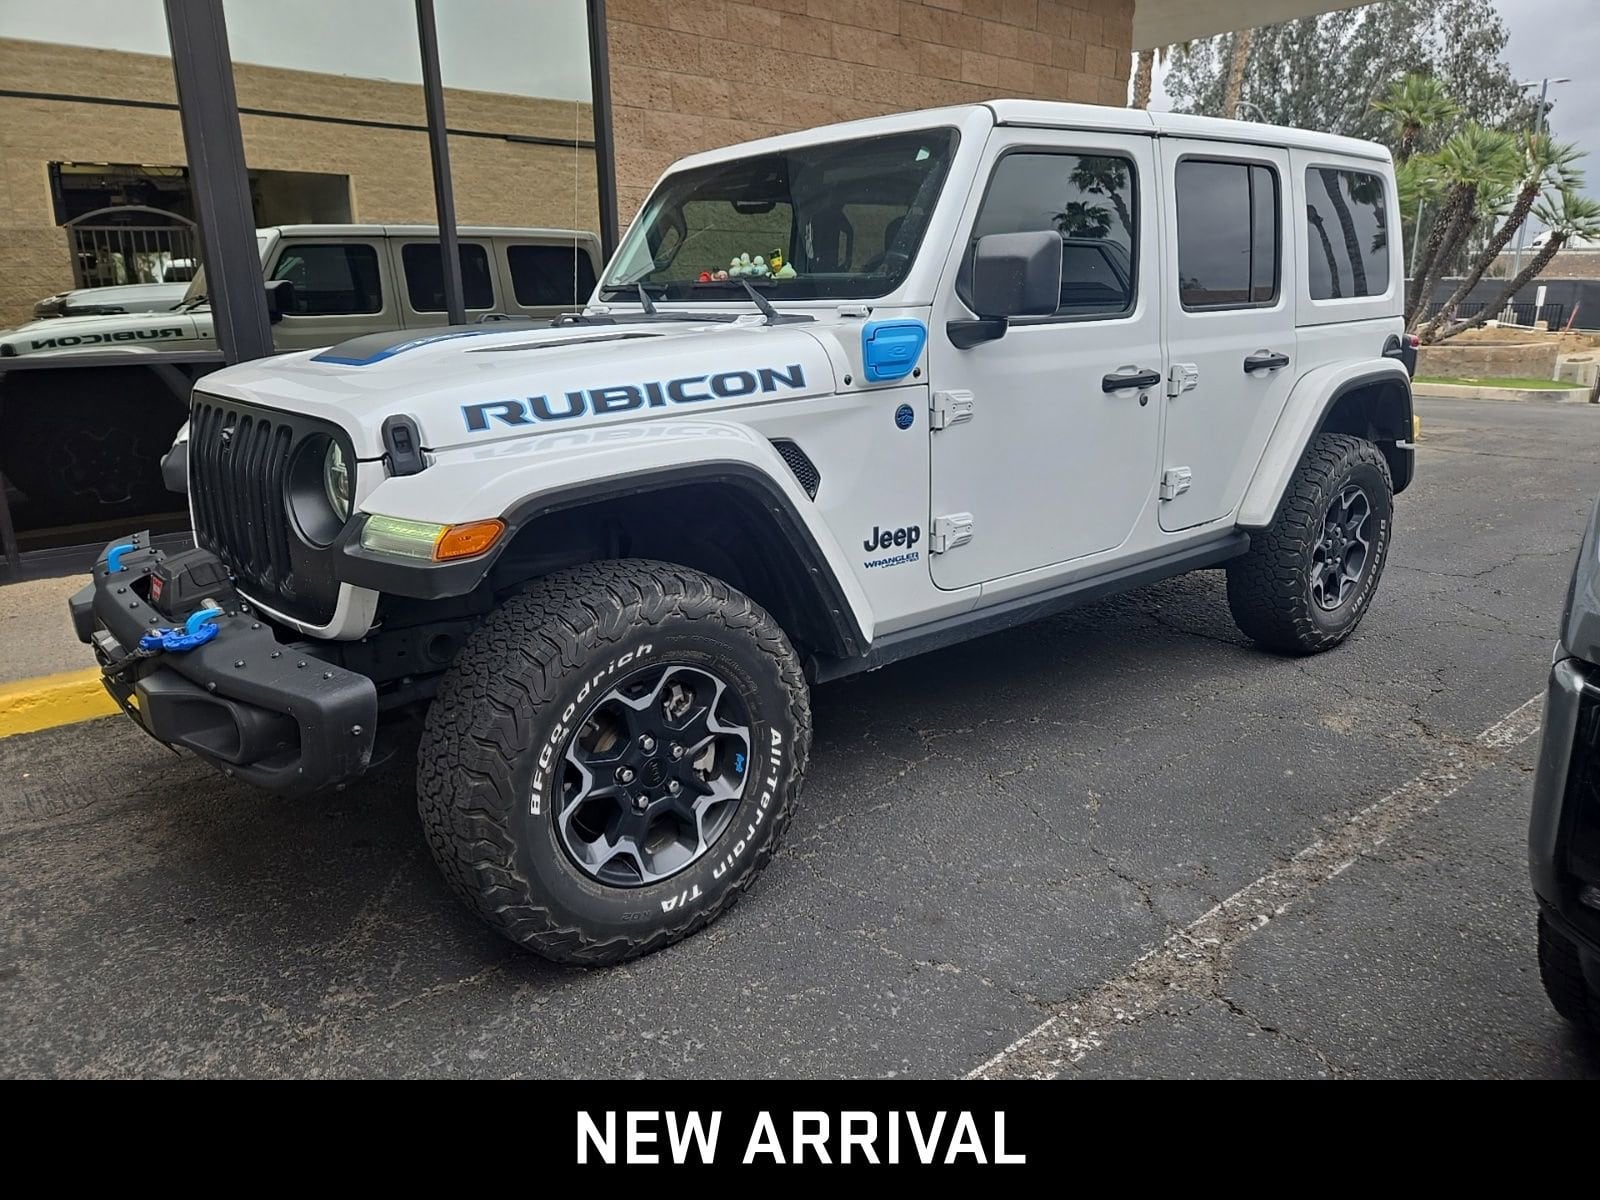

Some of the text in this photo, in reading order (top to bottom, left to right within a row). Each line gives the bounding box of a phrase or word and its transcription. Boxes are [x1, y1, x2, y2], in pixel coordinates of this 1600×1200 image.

[460, 363, 806, 432] RUBICON
[863, 525, 920, 552] Jeep
[863, 552, 919, 568] WRANGLER
[529, 643, 653, 816] BFGoodrich
[713, 726, 782, 880] All-Terrain
[660, 884, 703, 913] T/A
